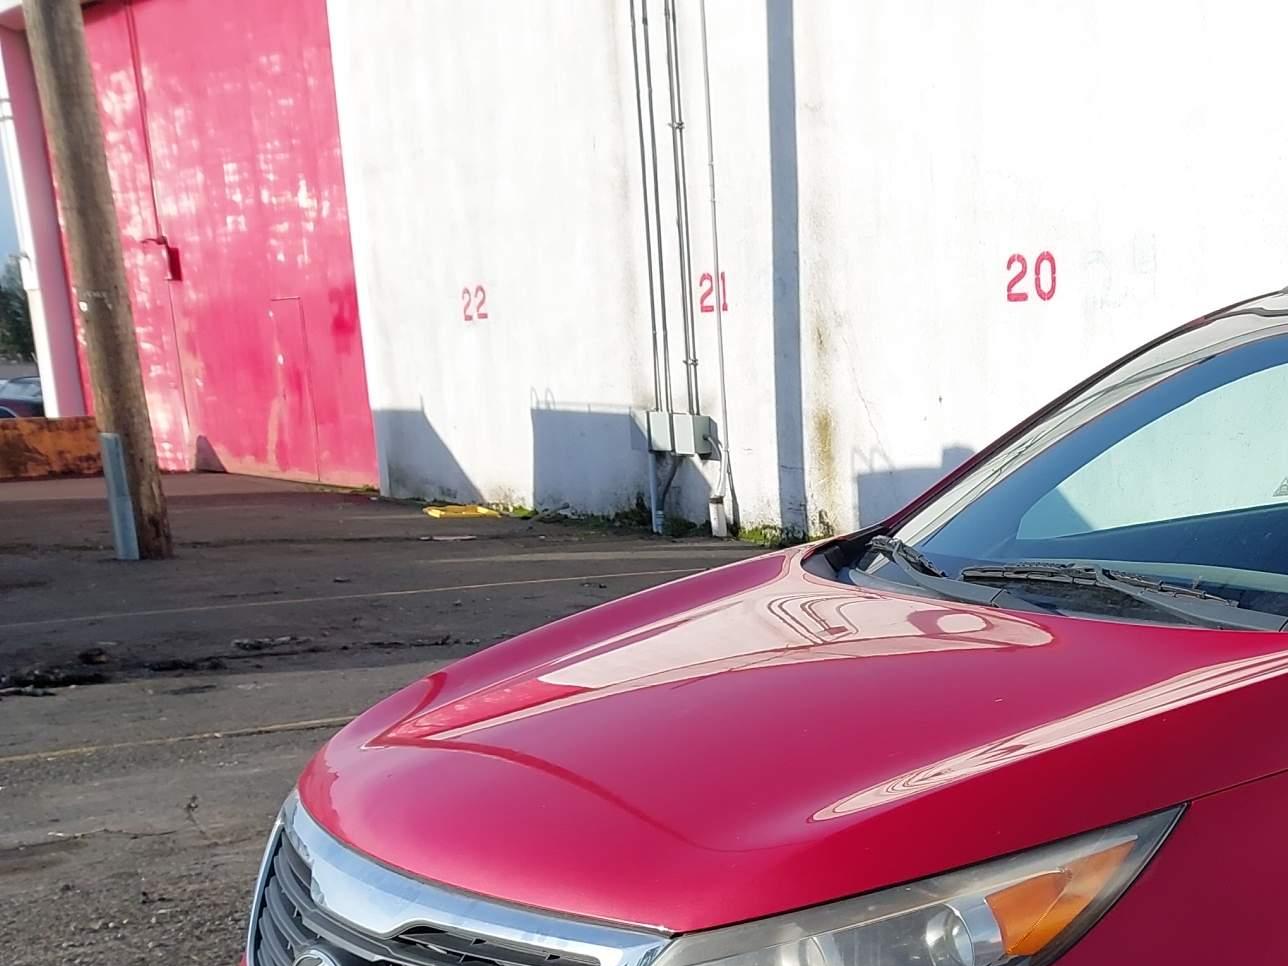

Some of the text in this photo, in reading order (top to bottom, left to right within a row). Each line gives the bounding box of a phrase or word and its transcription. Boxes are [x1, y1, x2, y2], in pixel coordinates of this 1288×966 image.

[698, 271, 729, 313] 21
[1006, 250, 1057, 302] 20
[461, 284, 489, 321] 22
